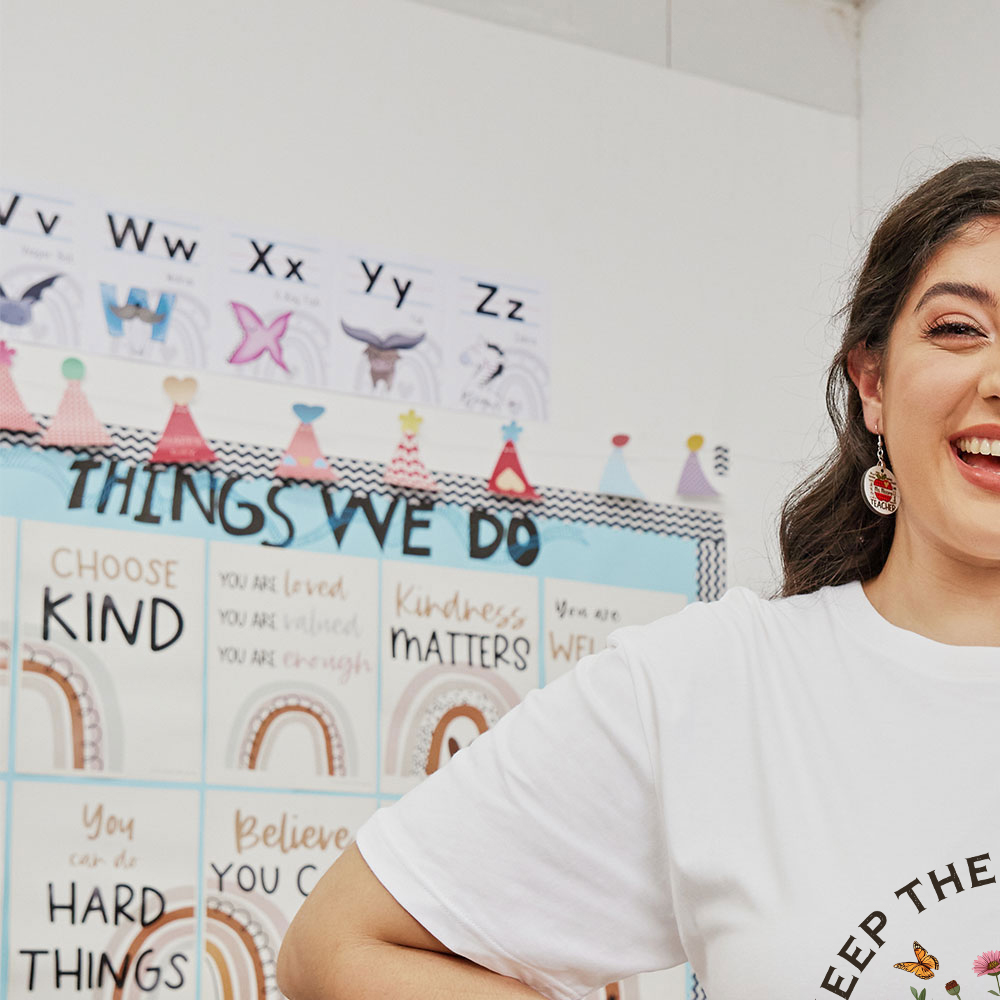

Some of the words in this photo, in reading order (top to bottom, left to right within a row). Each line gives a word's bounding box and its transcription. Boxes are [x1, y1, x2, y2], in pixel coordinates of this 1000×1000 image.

[67, 459, 295, 548] THINGS
[321, 486, 434, 556] WE
[470, 506, 541, 567] DO
[51, 547, 179, 589] CHOOSE
[219, 572, 248, 590] YOU
[253, 575, 277, 593] ARE
[284, 568, 347, 600] loved
[42, 586, 184, 652] KIND
[218, 609, 248, 627] YOU
[394, 582, 527, 630] Kindness
[218, 645, 248, 665] YOU
[390, 626, 531, 671] MATTERS
[82, 803, 135, 841] You
[234, 809, 350, 853] Believe
[69, 853, 104, 869] can
[212, 862, 279, 895] YOU
[894, 852, 997, 914] THE
[48, 881, 165, 927] HARD
[19, 947, 189, 992] THINGS
